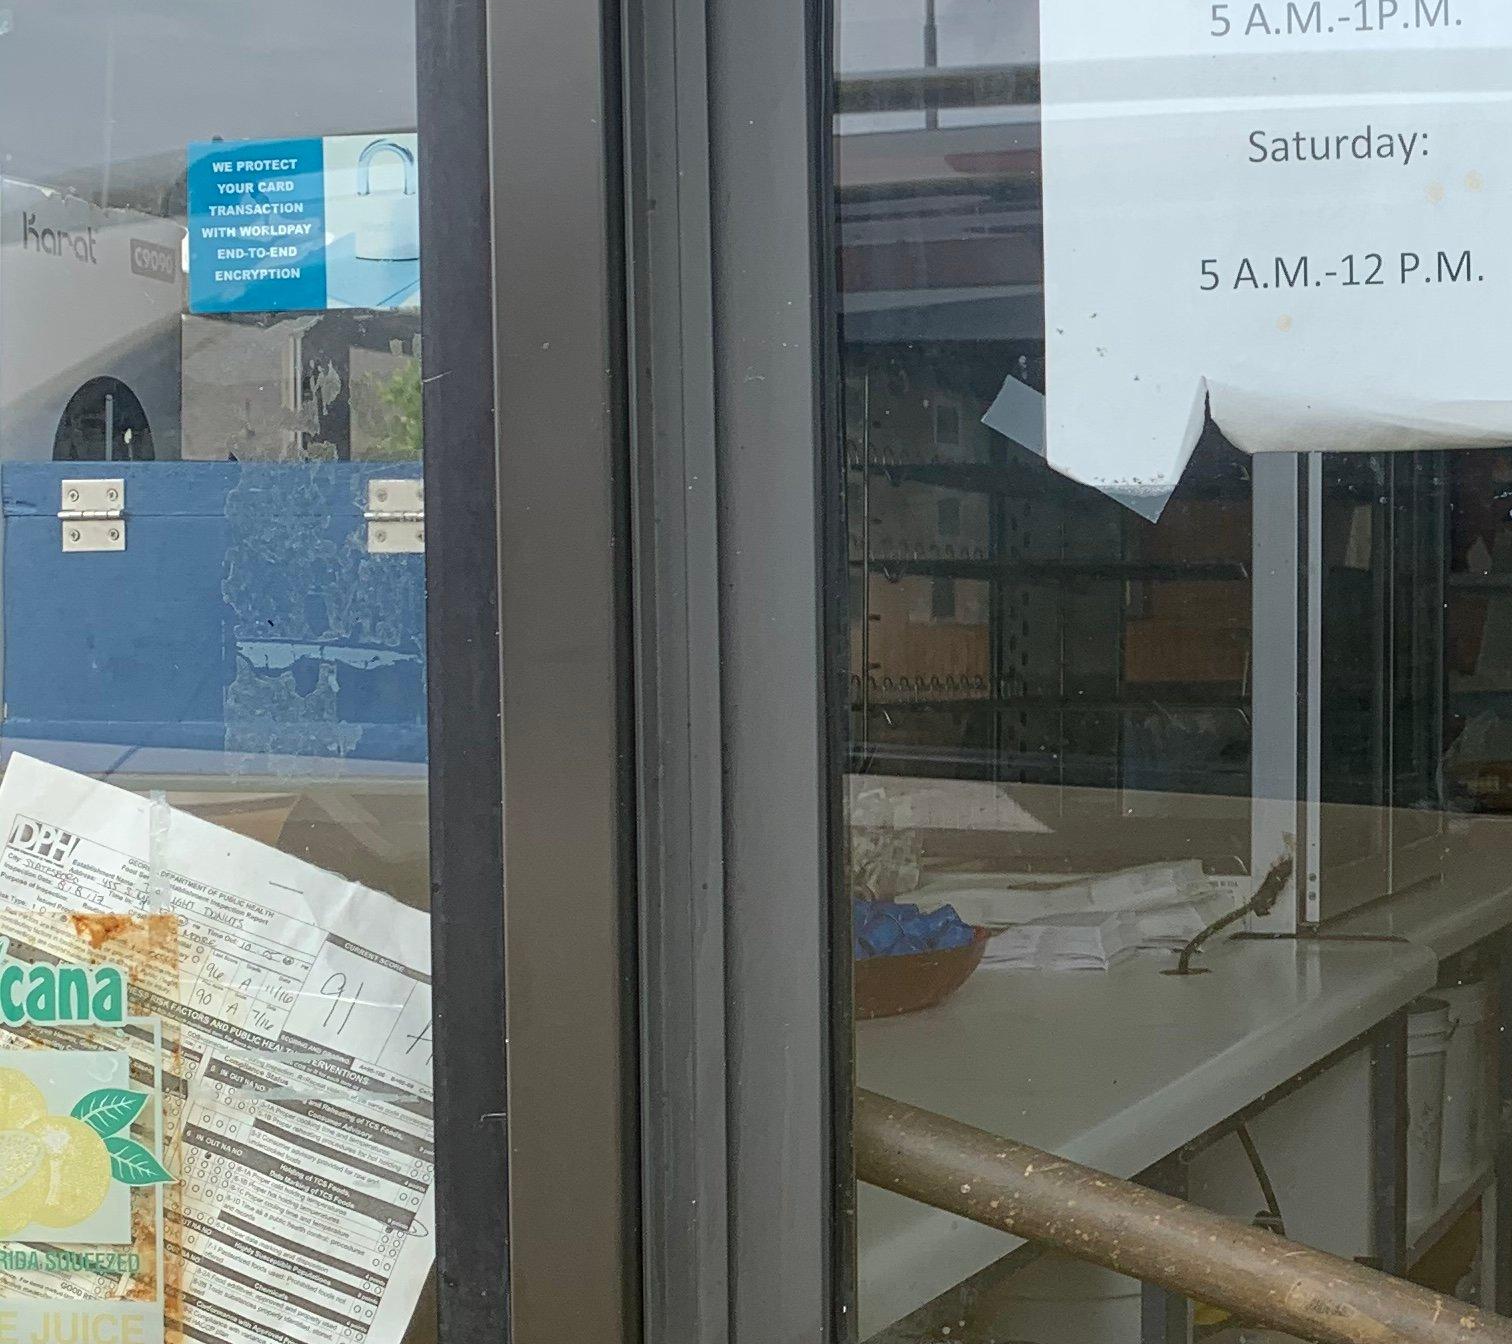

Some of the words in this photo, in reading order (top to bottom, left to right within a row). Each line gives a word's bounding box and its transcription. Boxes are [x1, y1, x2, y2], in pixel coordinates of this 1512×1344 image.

[1210, 4, 1231, 37] 5
[1247, 125, 1430, 165] Saturday:
[212, 161, 233, 173] WE
[236, 159, 298, 172] PROTECT
[217, 182, 254, 194] YOUR
[258, 181, 294, 192] CARD
[208, 202, 304, 216] TRANSACTION
[201, 227, 236, 238] WITH
[240, 223, 312, 237] WORLDPAY
[217, 246, 298, 260] END-TO-END
[215, 267, 301, 282] ENCRYPTION
[1201, 259, 1219, 291] 5
[1232, 253, 1384, 289] A.M.-12
[1399, 249, 1484, 285] P.M.
[12, 819, 76, 862] DPH
[128, 858, 150, 871] GEORG
[160, 869, 206, 894] DEPARTMENT
[207, 888, 218, 897] OF
[218, 892, 244, 907] PUBLIC
[245, 903, 275, 918] HEALTH
[1, 965, 123, 1022] cana
[320, 972, 364, 1036] 91
[170, 1002, 210, 1027] FACTORS
[210, 1019, 229, 1032] AND
[229, 1027, 261, 1046] PUBLIC
[45, 1250, 140, 1272] SQUEEZED
